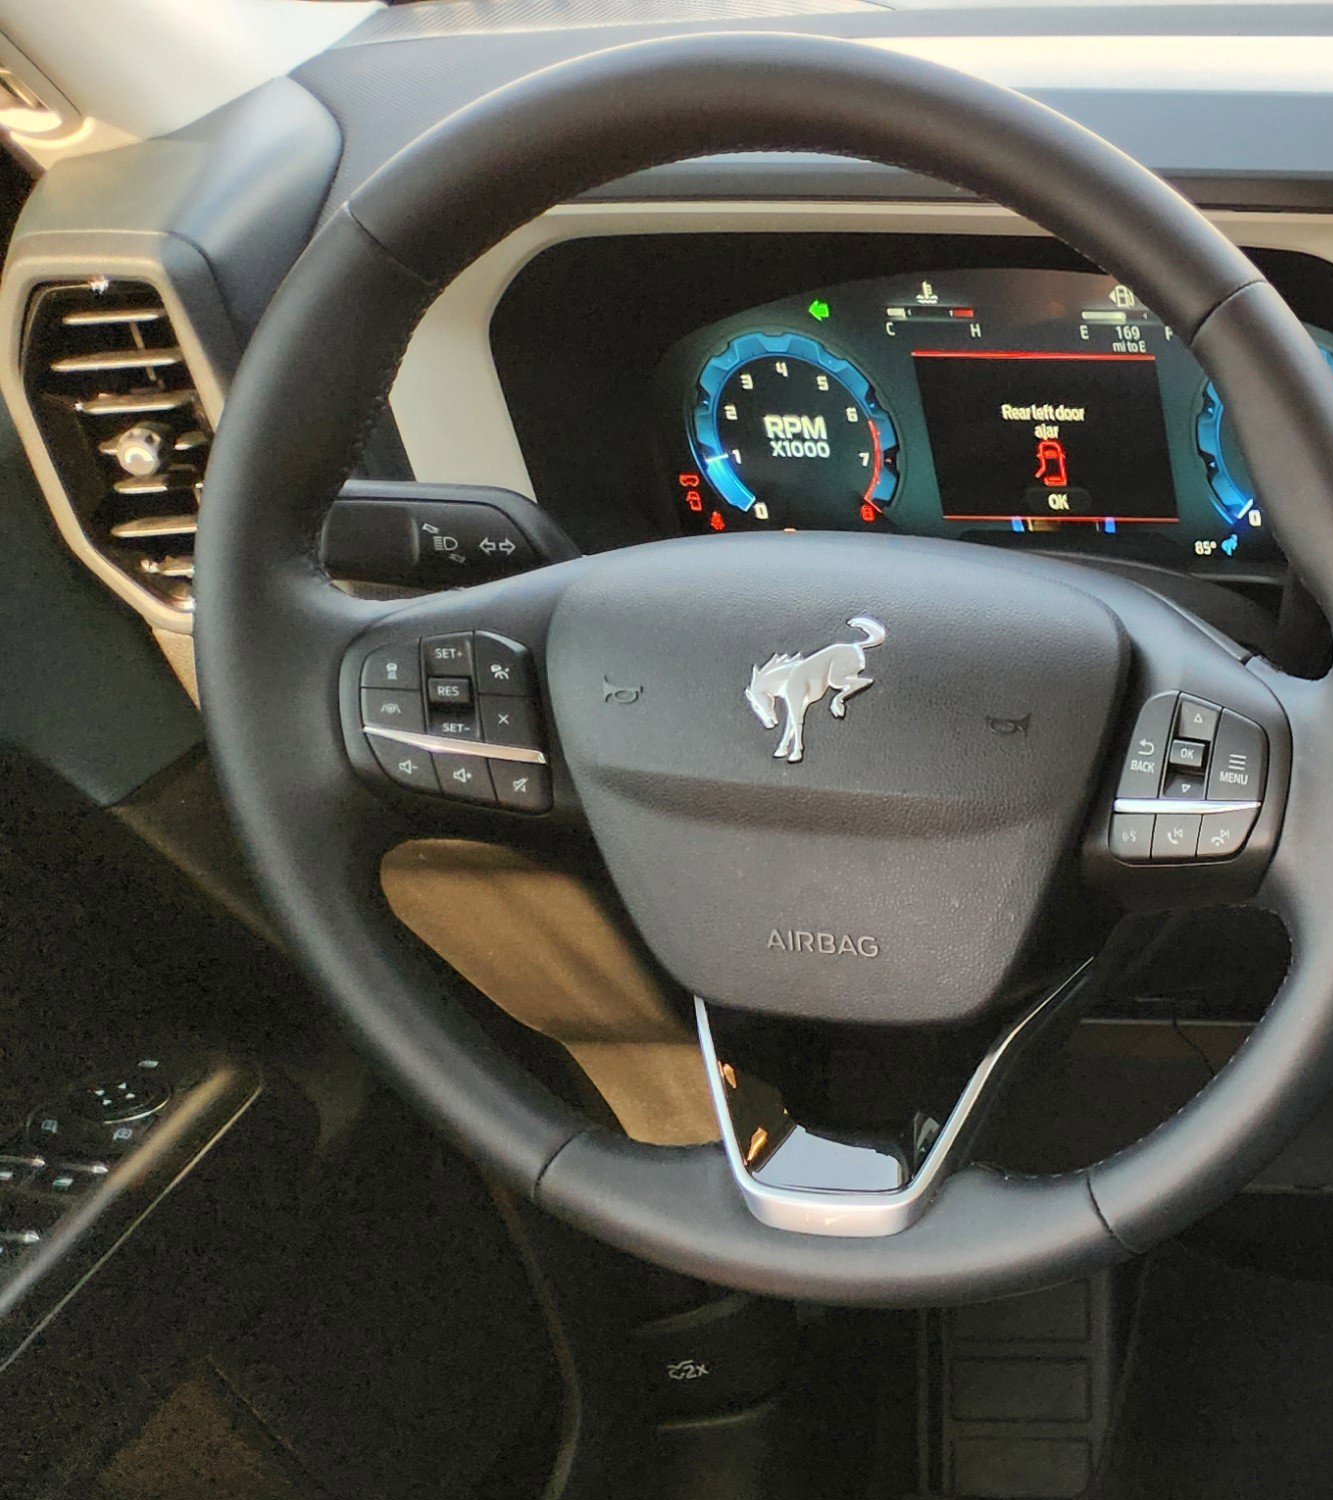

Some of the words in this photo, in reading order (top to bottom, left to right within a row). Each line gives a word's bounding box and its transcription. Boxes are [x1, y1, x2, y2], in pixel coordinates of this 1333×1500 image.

[885, 321, 896, 336] C
[969, 322, 982, 338] H
[1080, 325, 1090, 340] E
[1115, 325, 1141, 340] 169
[1112, 341, 1126, 352] mi
[1127, 340, 1138, 352] to
[1138, 340, 1147, 353] E
[775, 362, 788, 377] 4
[739, 374, 753, 389] 3
[816, 376, 828, 390] 5
[723, 405, 737, 420] 2
[845, 407, 858, 422] 6
[1001, 404, 1031, 420] Rear
[1031, 404, 1055, 421] left
[1055, 404, 1085, 421] door
[764, 415, 828, 440] RPM
[1034, 423, 1059, 441] ajar
[1048, 493, 1070, 510] OK
[437, 685, 460, 697] RES
[1180, 748, 1195, 760] OK
[1130, 759, 1155, 774] BACK
[1219, 771, 1249, 785] MENU
[766, 928, 881, 959] AIRBAG
